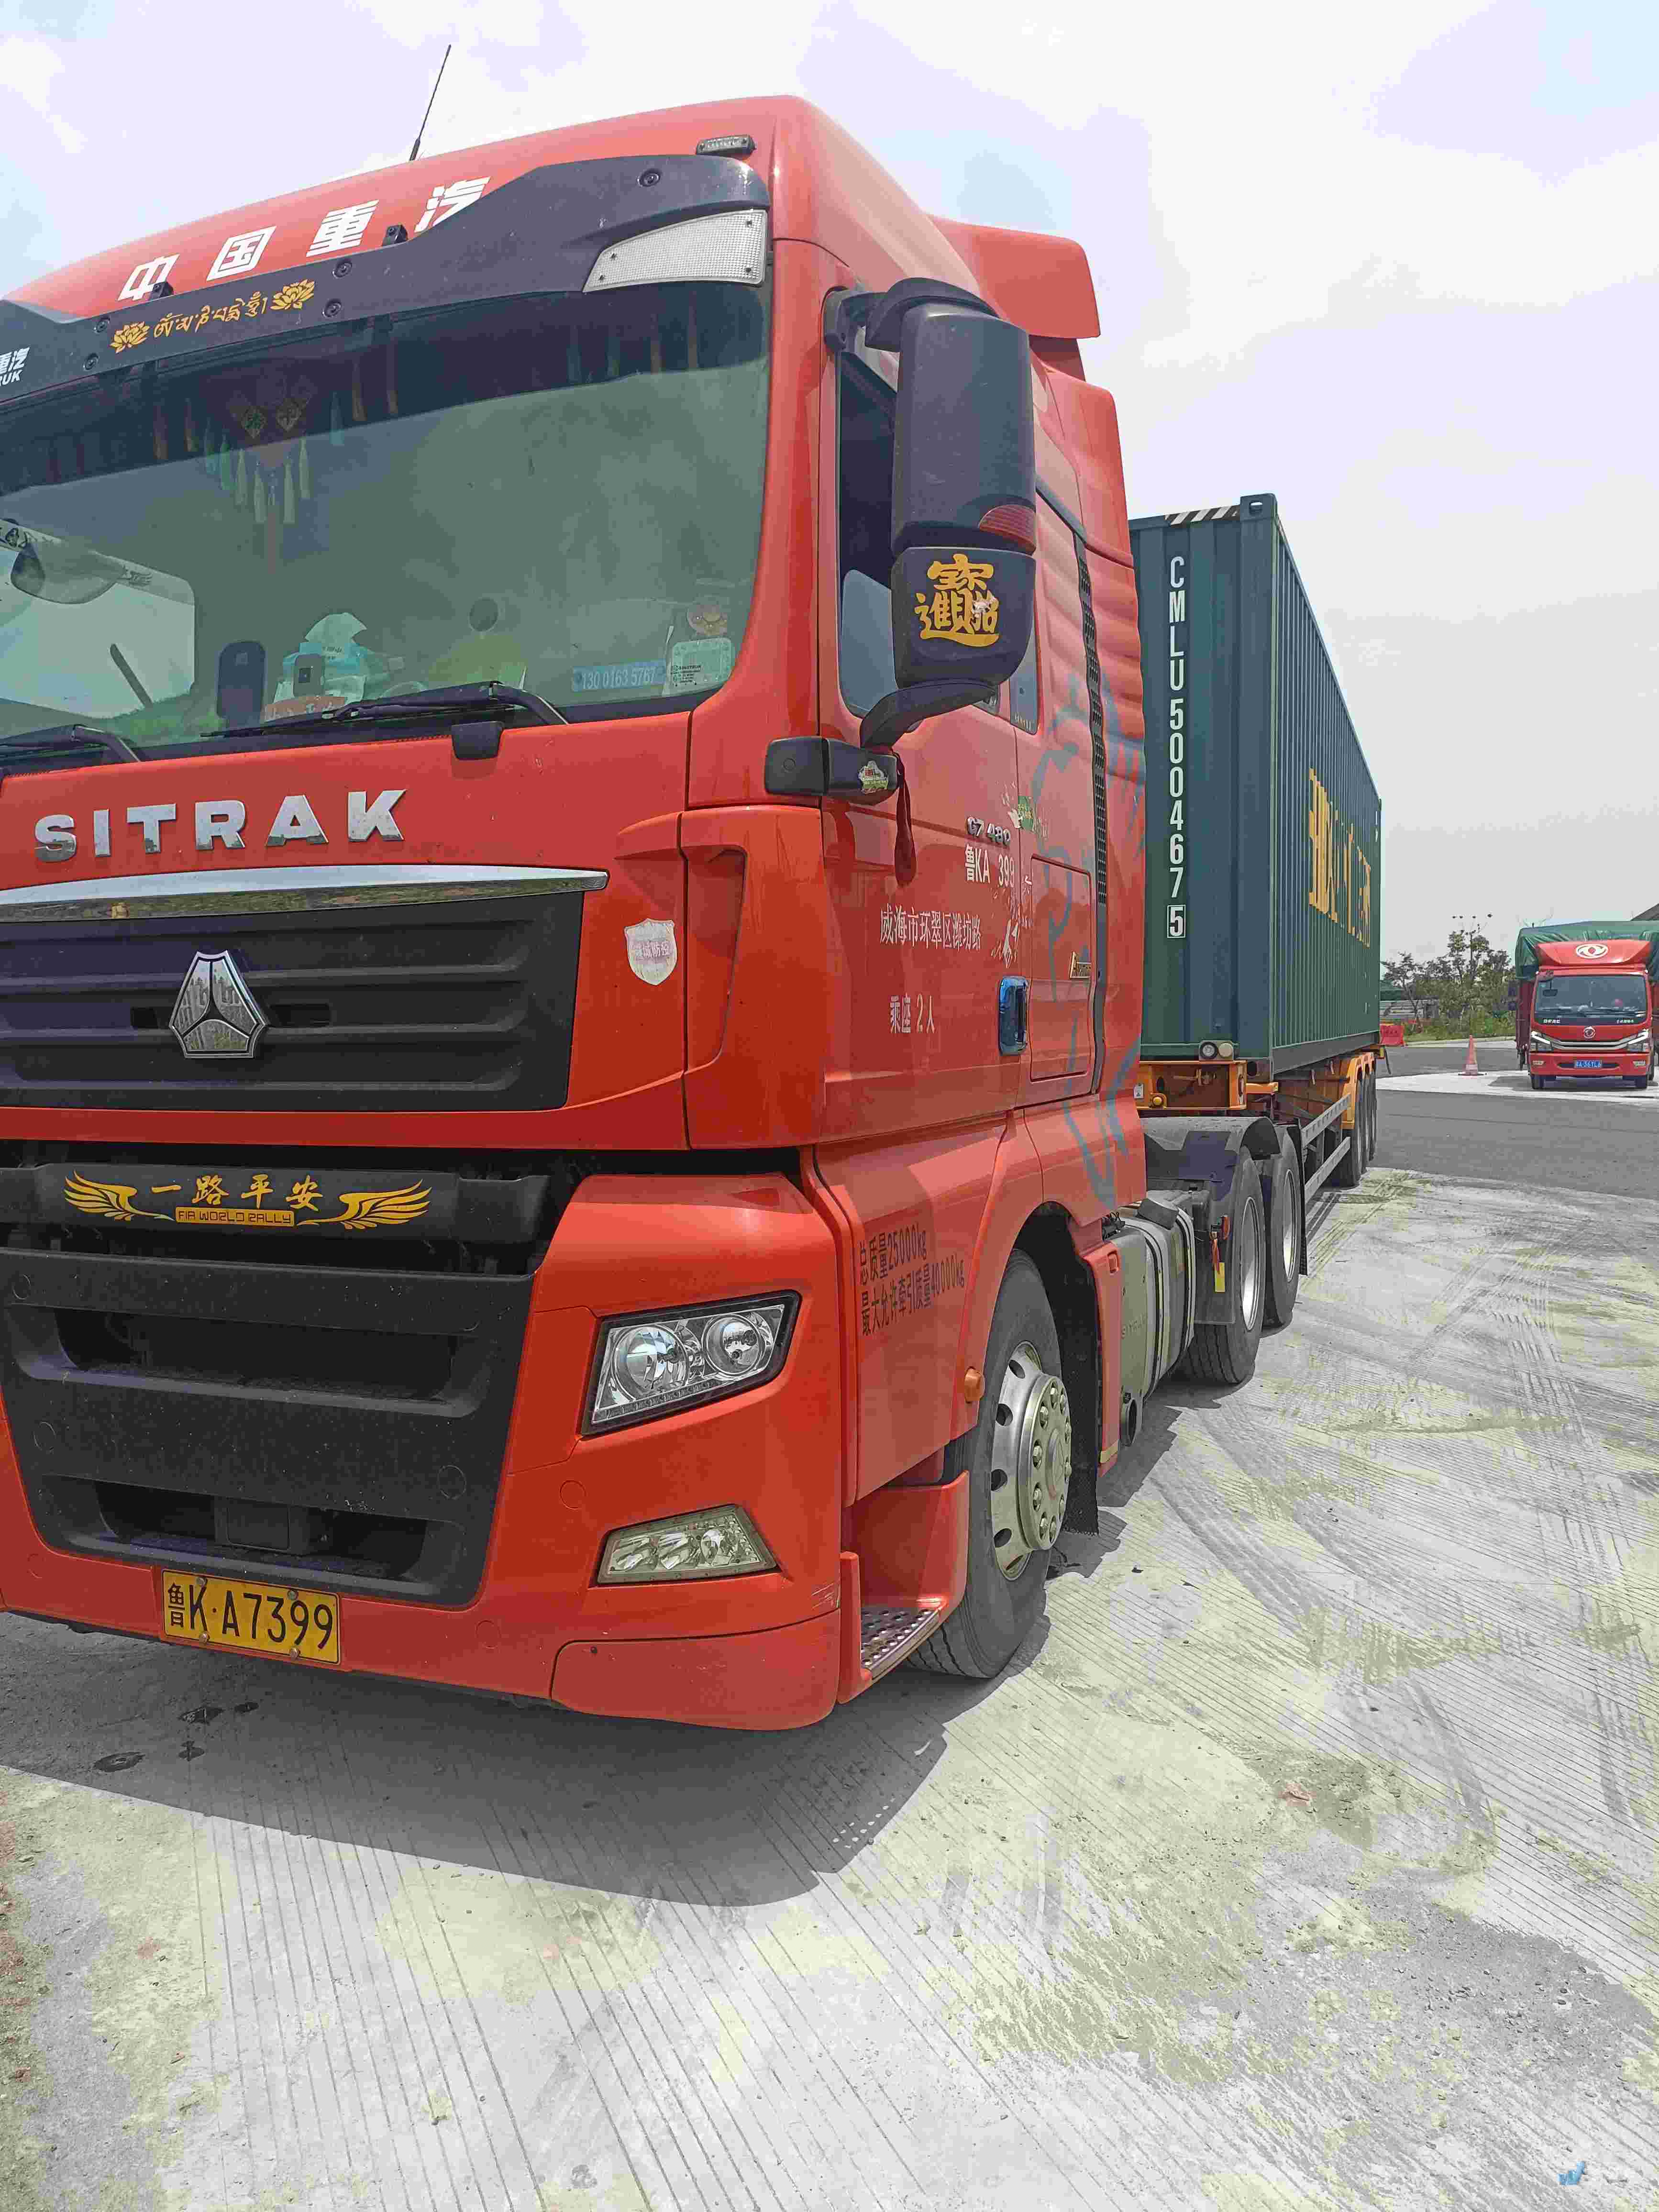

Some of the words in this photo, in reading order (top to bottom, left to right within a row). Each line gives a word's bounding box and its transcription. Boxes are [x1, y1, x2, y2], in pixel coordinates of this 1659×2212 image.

[117, 176, 491, 302] 中国重汽
[34, 789, 406, 862] SITRAK
[880, 903, 981, 951] 威海市环翠区潍坊路
[151, 1174, 323, 1212] 一路平安
[178, 1210, 195, 1220] FIA
[199, 1211, 245, 1223] WORLD
[248, 1213, 291, 1225] RALLY
